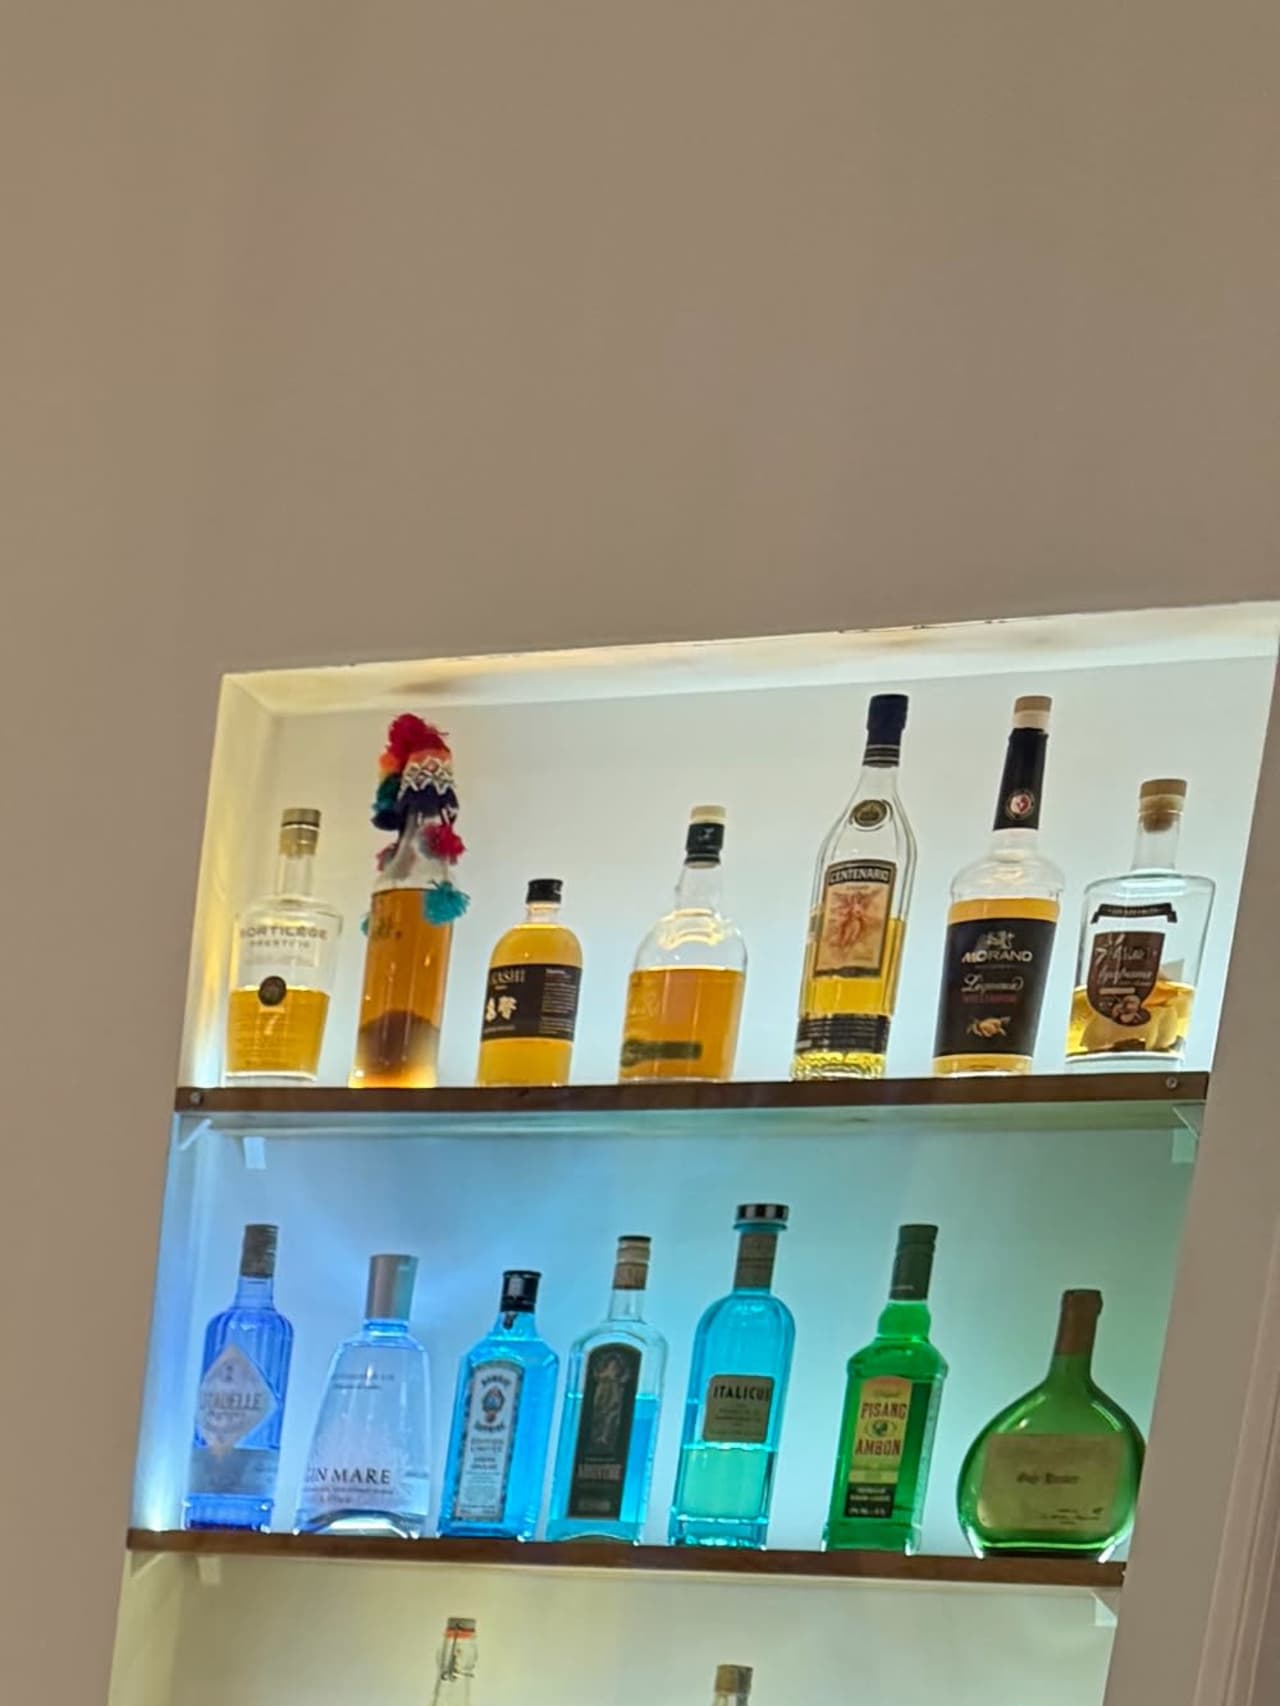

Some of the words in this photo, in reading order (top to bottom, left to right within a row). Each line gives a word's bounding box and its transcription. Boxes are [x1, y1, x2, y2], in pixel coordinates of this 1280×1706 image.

[860, 1401, 908, 1419] PISANG
[854, 1439, 901, 1456] AMBON
[331, 1467, 392, 1485] MARE
